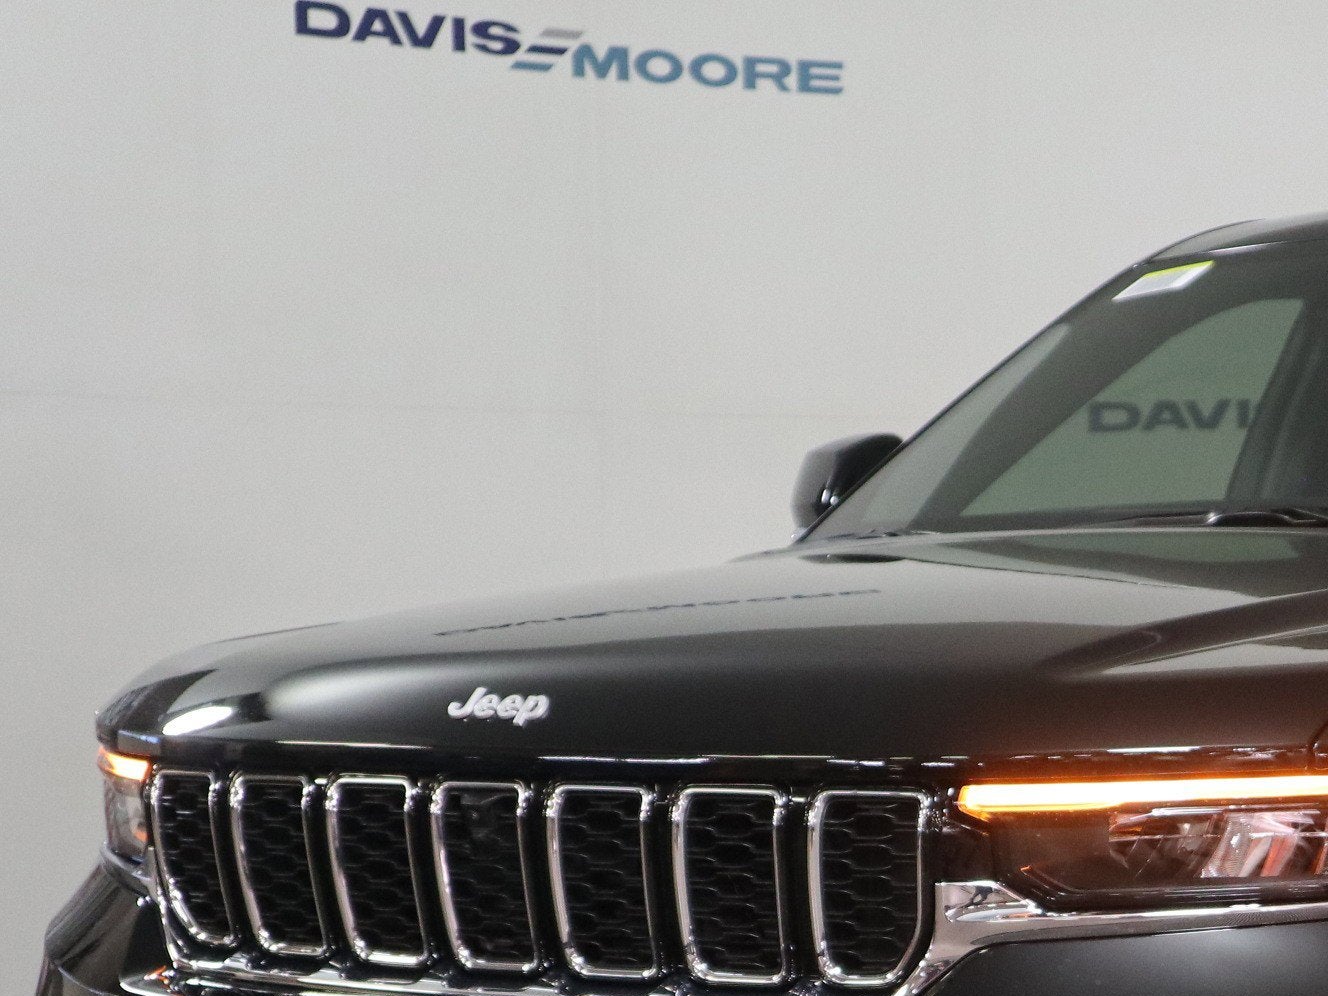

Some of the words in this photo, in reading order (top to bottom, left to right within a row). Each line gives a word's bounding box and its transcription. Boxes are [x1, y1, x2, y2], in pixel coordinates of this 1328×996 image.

[295, 0, 521, 55] DAVIS
[571, 43, 844, 95] MOORE
[1087, 399, 1252, 433] DAVI
[447, 686, 550, 727] Jeep
